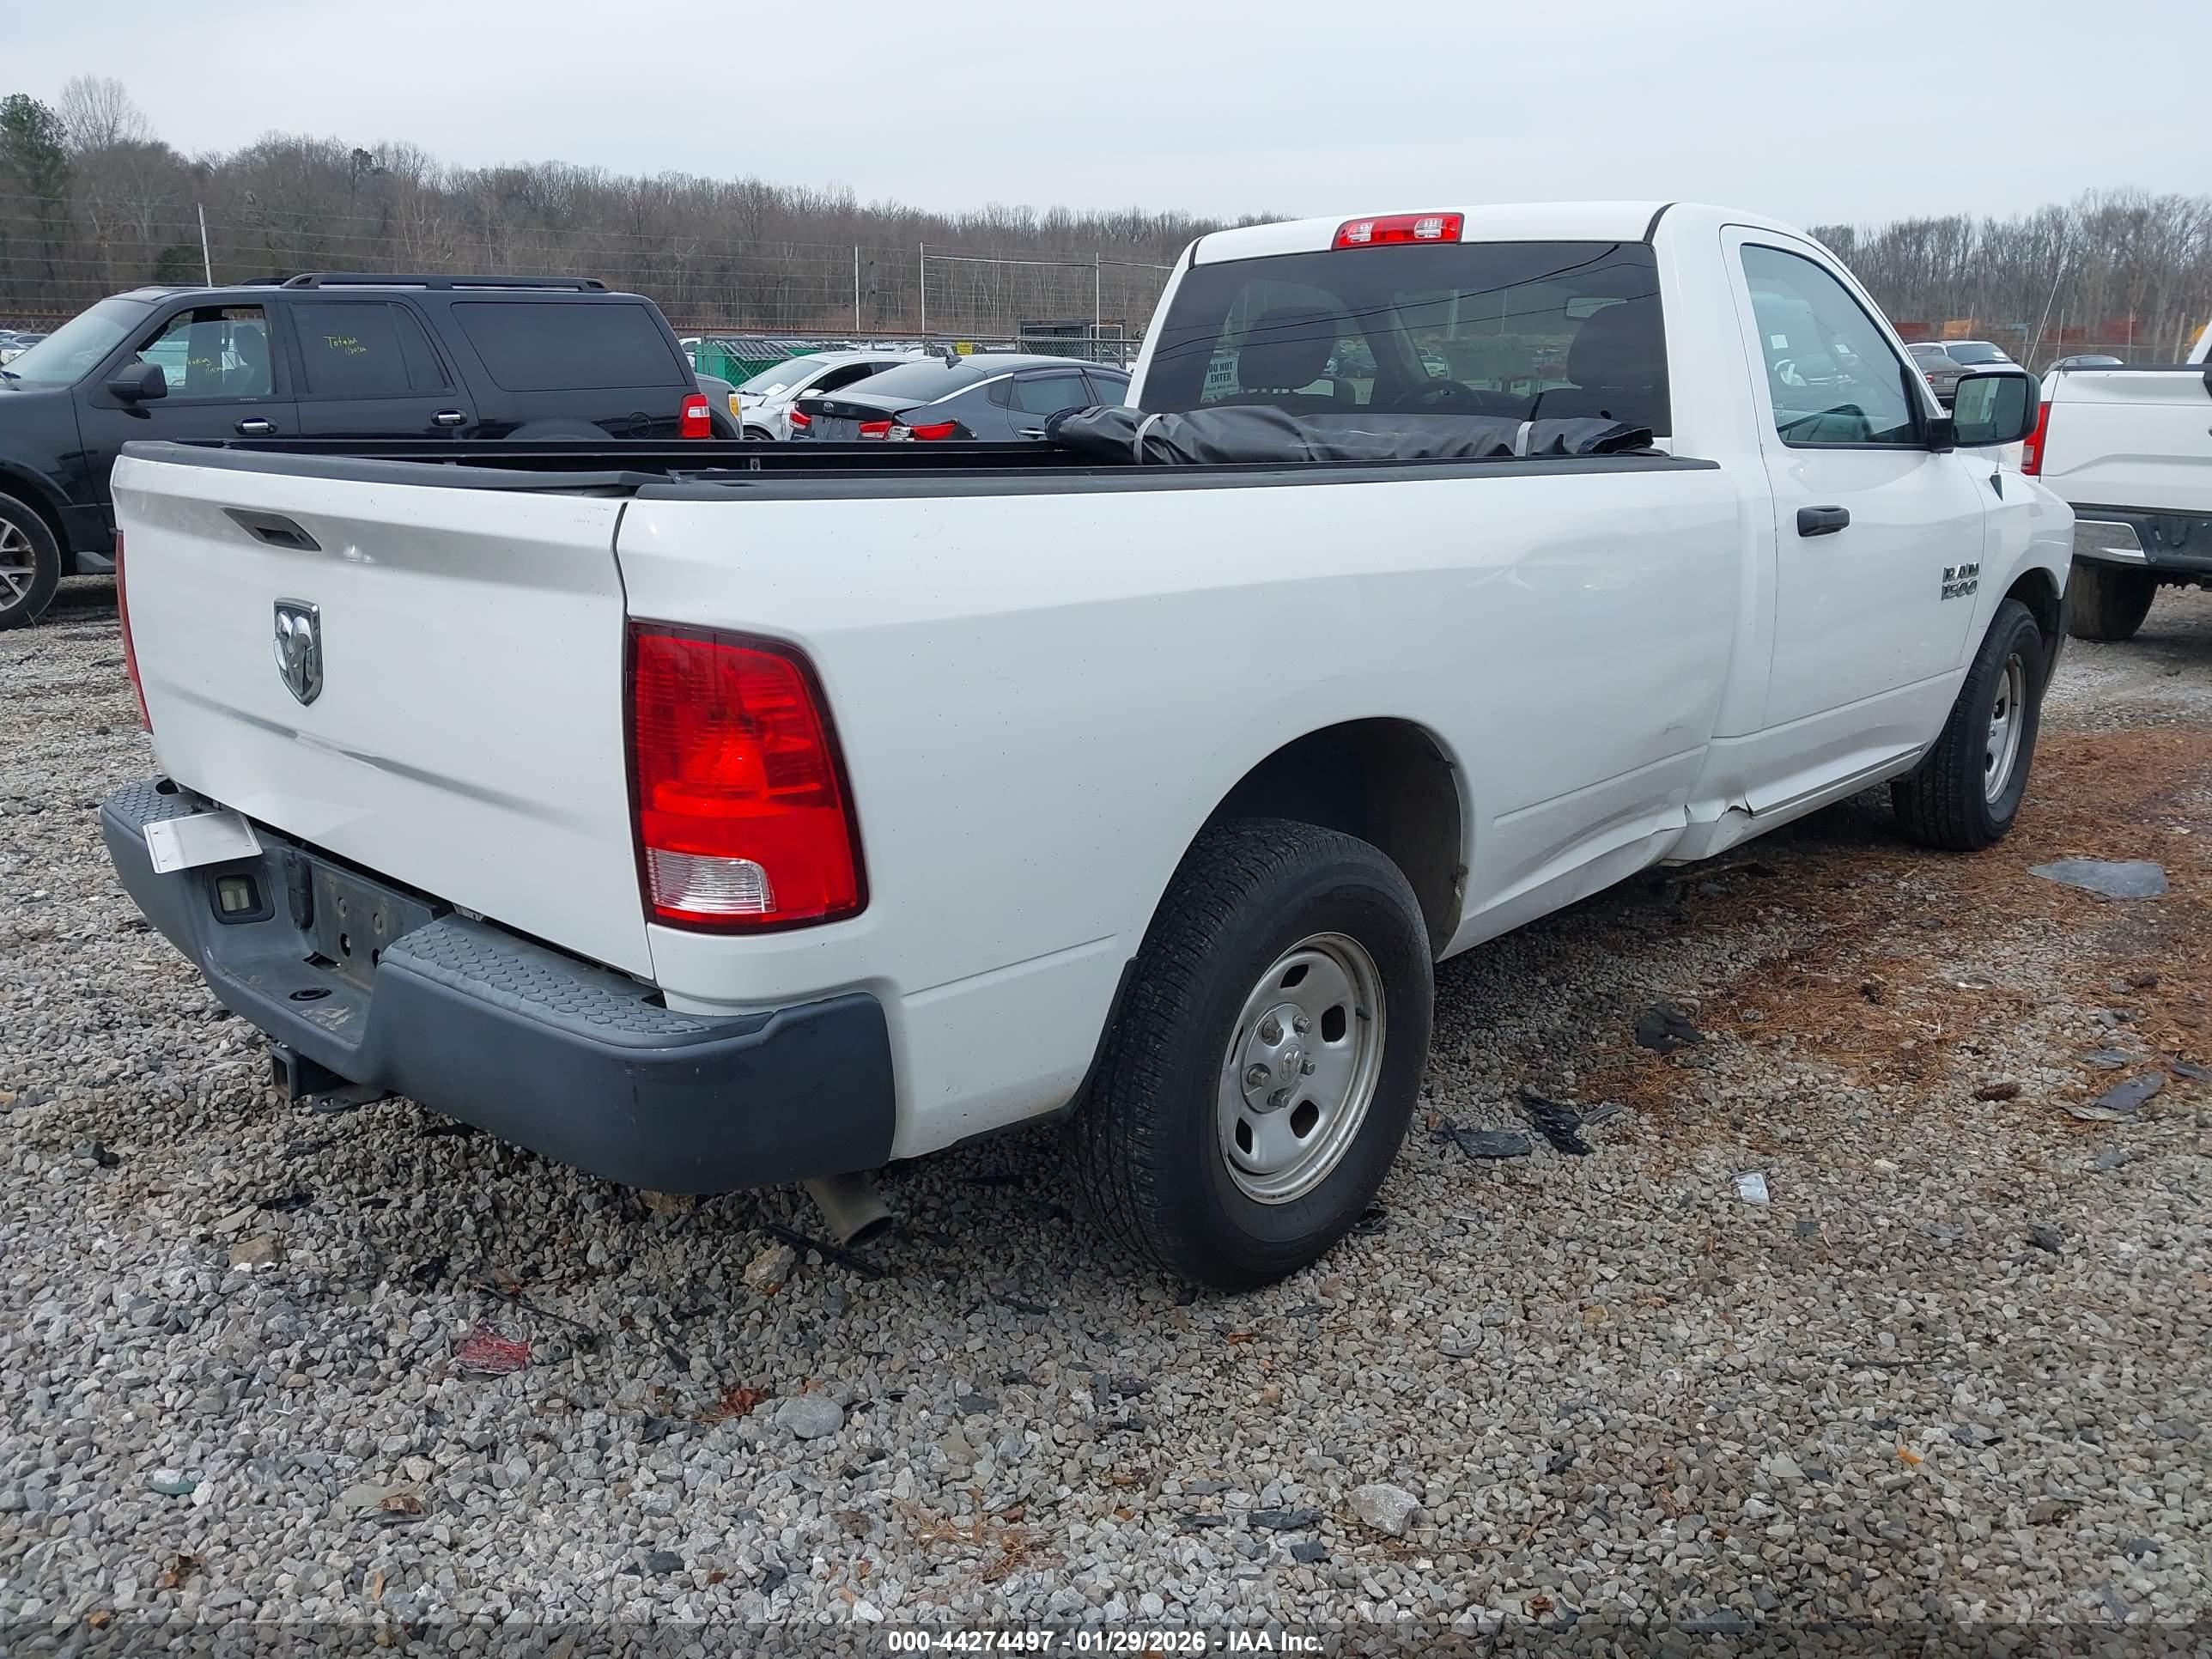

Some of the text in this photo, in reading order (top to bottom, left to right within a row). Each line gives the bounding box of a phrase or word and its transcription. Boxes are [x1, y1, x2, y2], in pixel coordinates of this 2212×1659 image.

[1219, 362, 1233, 372] NOT
[1211, 373, 1231, 383] ENTER
[1942, 562, 1980, 582] RAM
[1941, 580, 1978, 601] 1500
